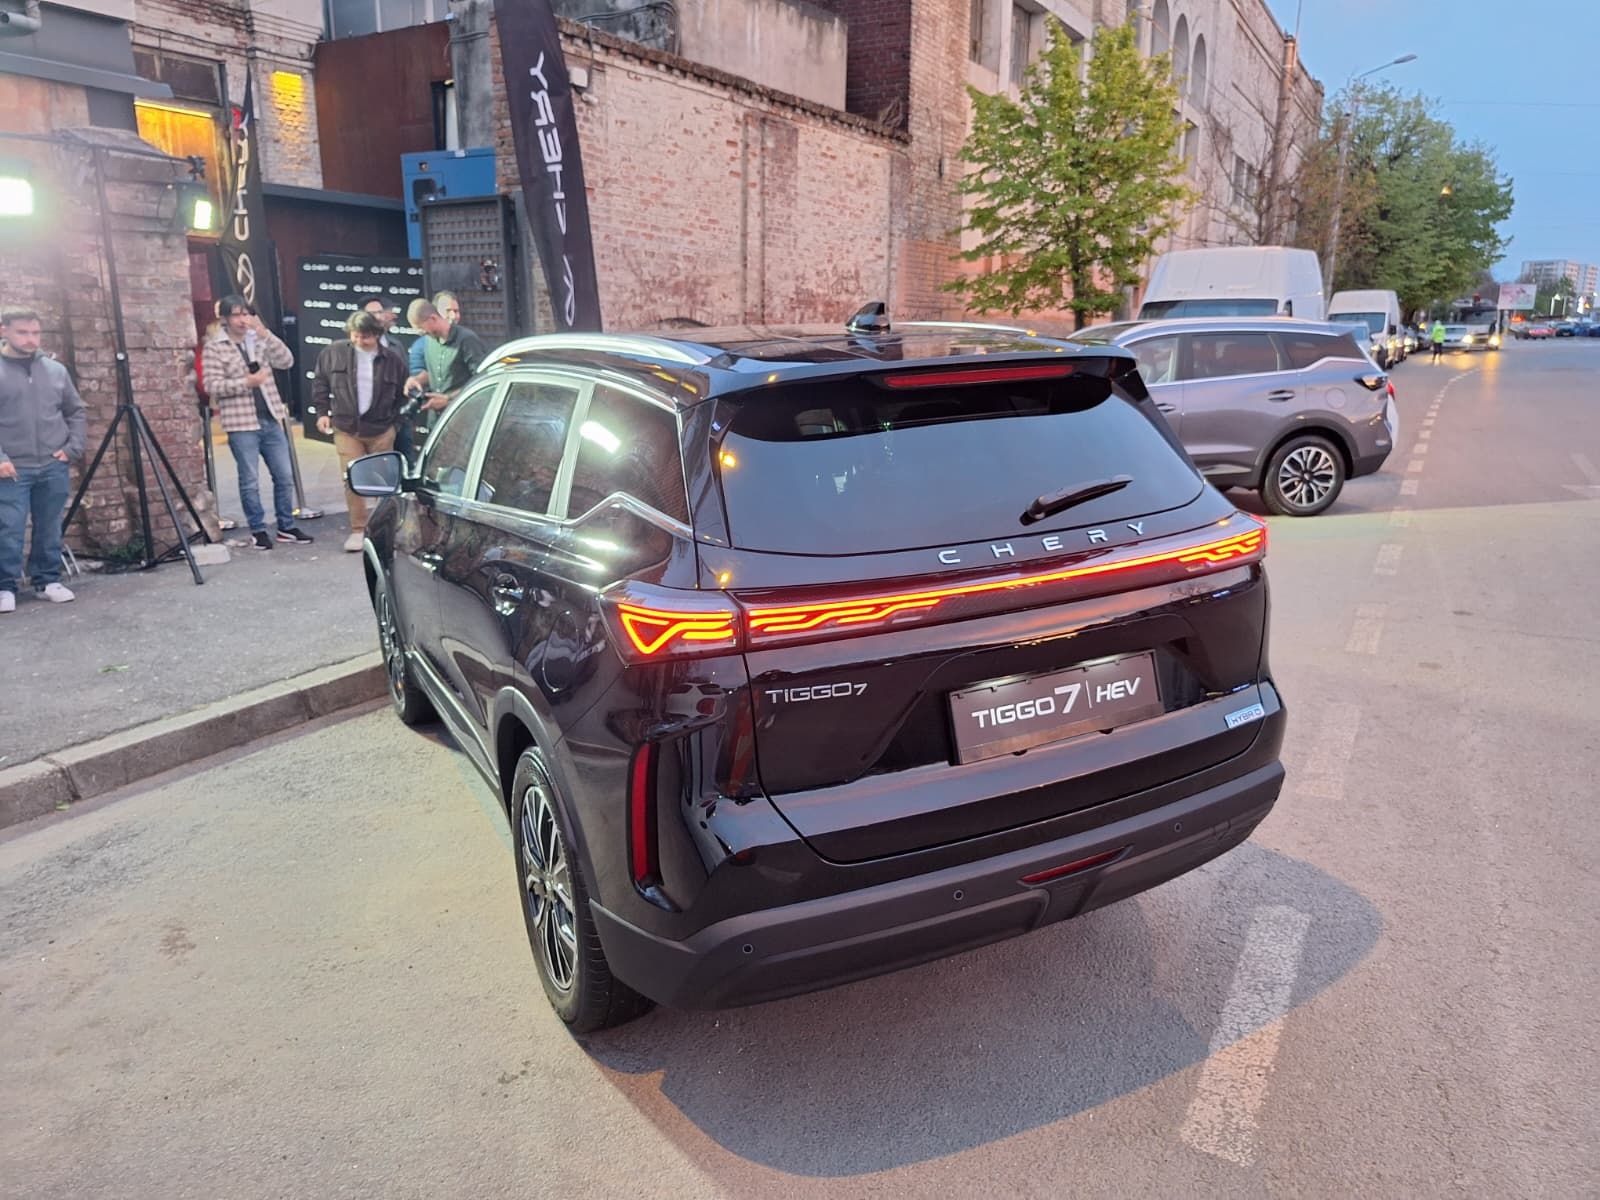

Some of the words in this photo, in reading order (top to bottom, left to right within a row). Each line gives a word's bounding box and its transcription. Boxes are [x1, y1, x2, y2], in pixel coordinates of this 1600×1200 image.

[938, 522, 1144, 565] CHERY
[1096, 677, 1141, 703] HEV
[1229, 708, 1261, 726] HYBRD
